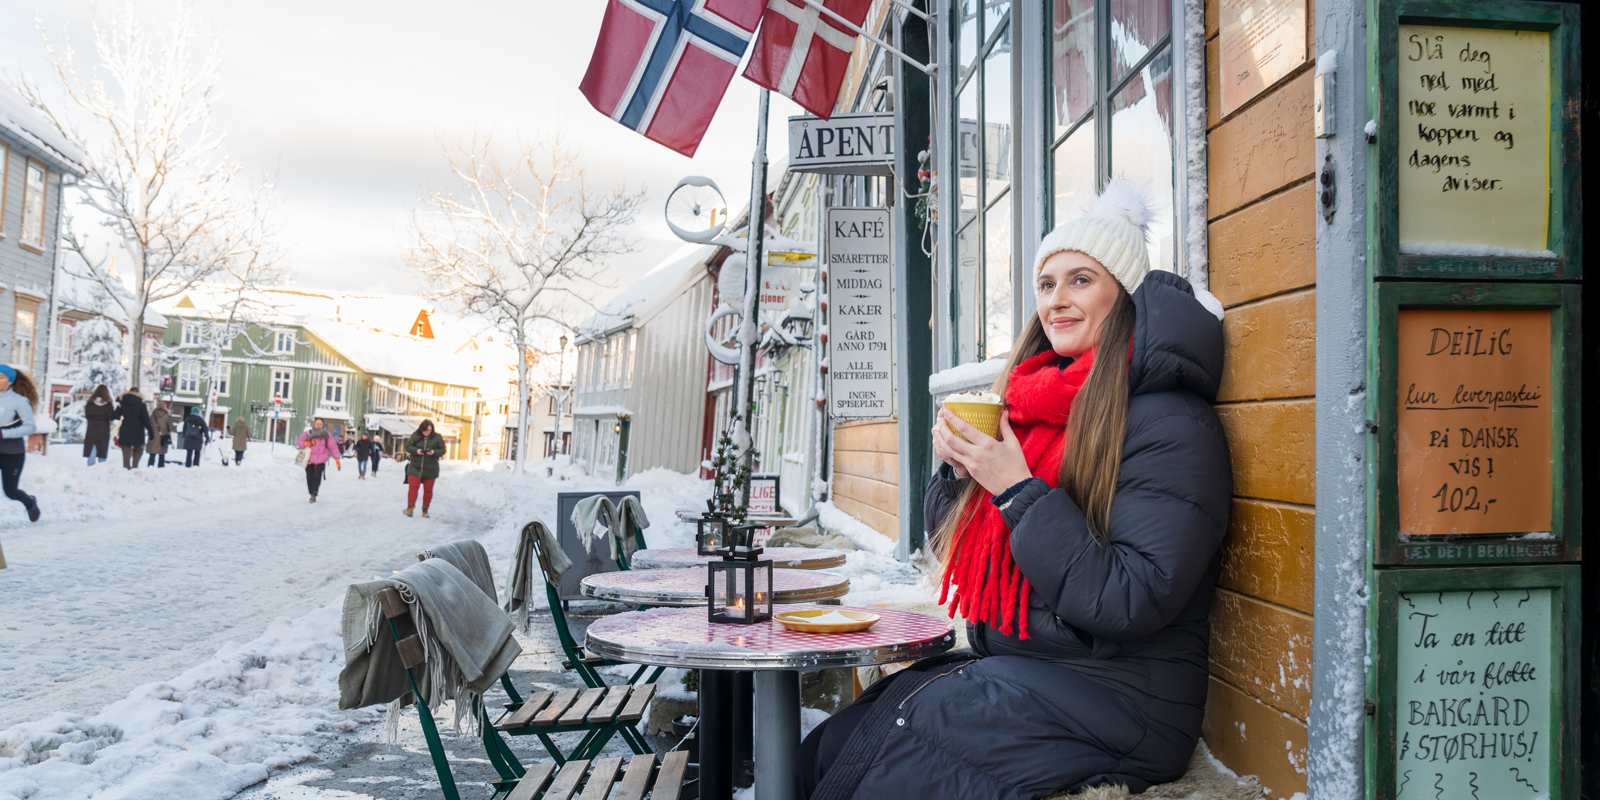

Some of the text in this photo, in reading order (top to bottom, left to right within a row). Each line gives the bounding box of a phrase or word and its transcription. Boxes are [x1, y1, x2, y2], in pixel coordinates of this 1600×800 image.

[1408, 34, 1491, 73] Slå deg
[1420, 71, 1499, 94] ned med
[1408, 99, 1516, 120] noe varmt i
[1418, 124, 1514, 150] koppen og
[1409, 149, 1471, 174] dagens
[834, 217, 885, 239] KAFÉ
[831, 252, 889, 265] SMÅRETTER
[837, 278, 882, 290] MIDDAG
[839, 304, 882, 316] KAKER
[837, 341, 887, 351] ANNO 1791
[845, 329, 875, 341] GÅRD
[1426, 326, 1513, 357] DEILIG
[833, 371, 889, 380] RETTIGHETER
[846, 361, 873, 370] ALLE
[837, 399, 885, 408] SPISEPLIKT
[848, 391, 877, 400] INGEN
[1405, 383, 1542, 411] lun leverpostei
[1429, 426, 1519, 448] PÅ DANSK
[1432, 482, 1497, 515] 102,-
[1404, 546, 1431, 560] LÆS
[1437, 545, 1464, 559] DET
[1467, 545, 1472, 558] I
[1408, 612, 1526, 649] Ta en titt
[1414, 660, 1537, 689] i vår flotte
[1408, 691, 1530, 727] BAKGÅRD
[1415, 730, 1538, 763] STØRHUS!
